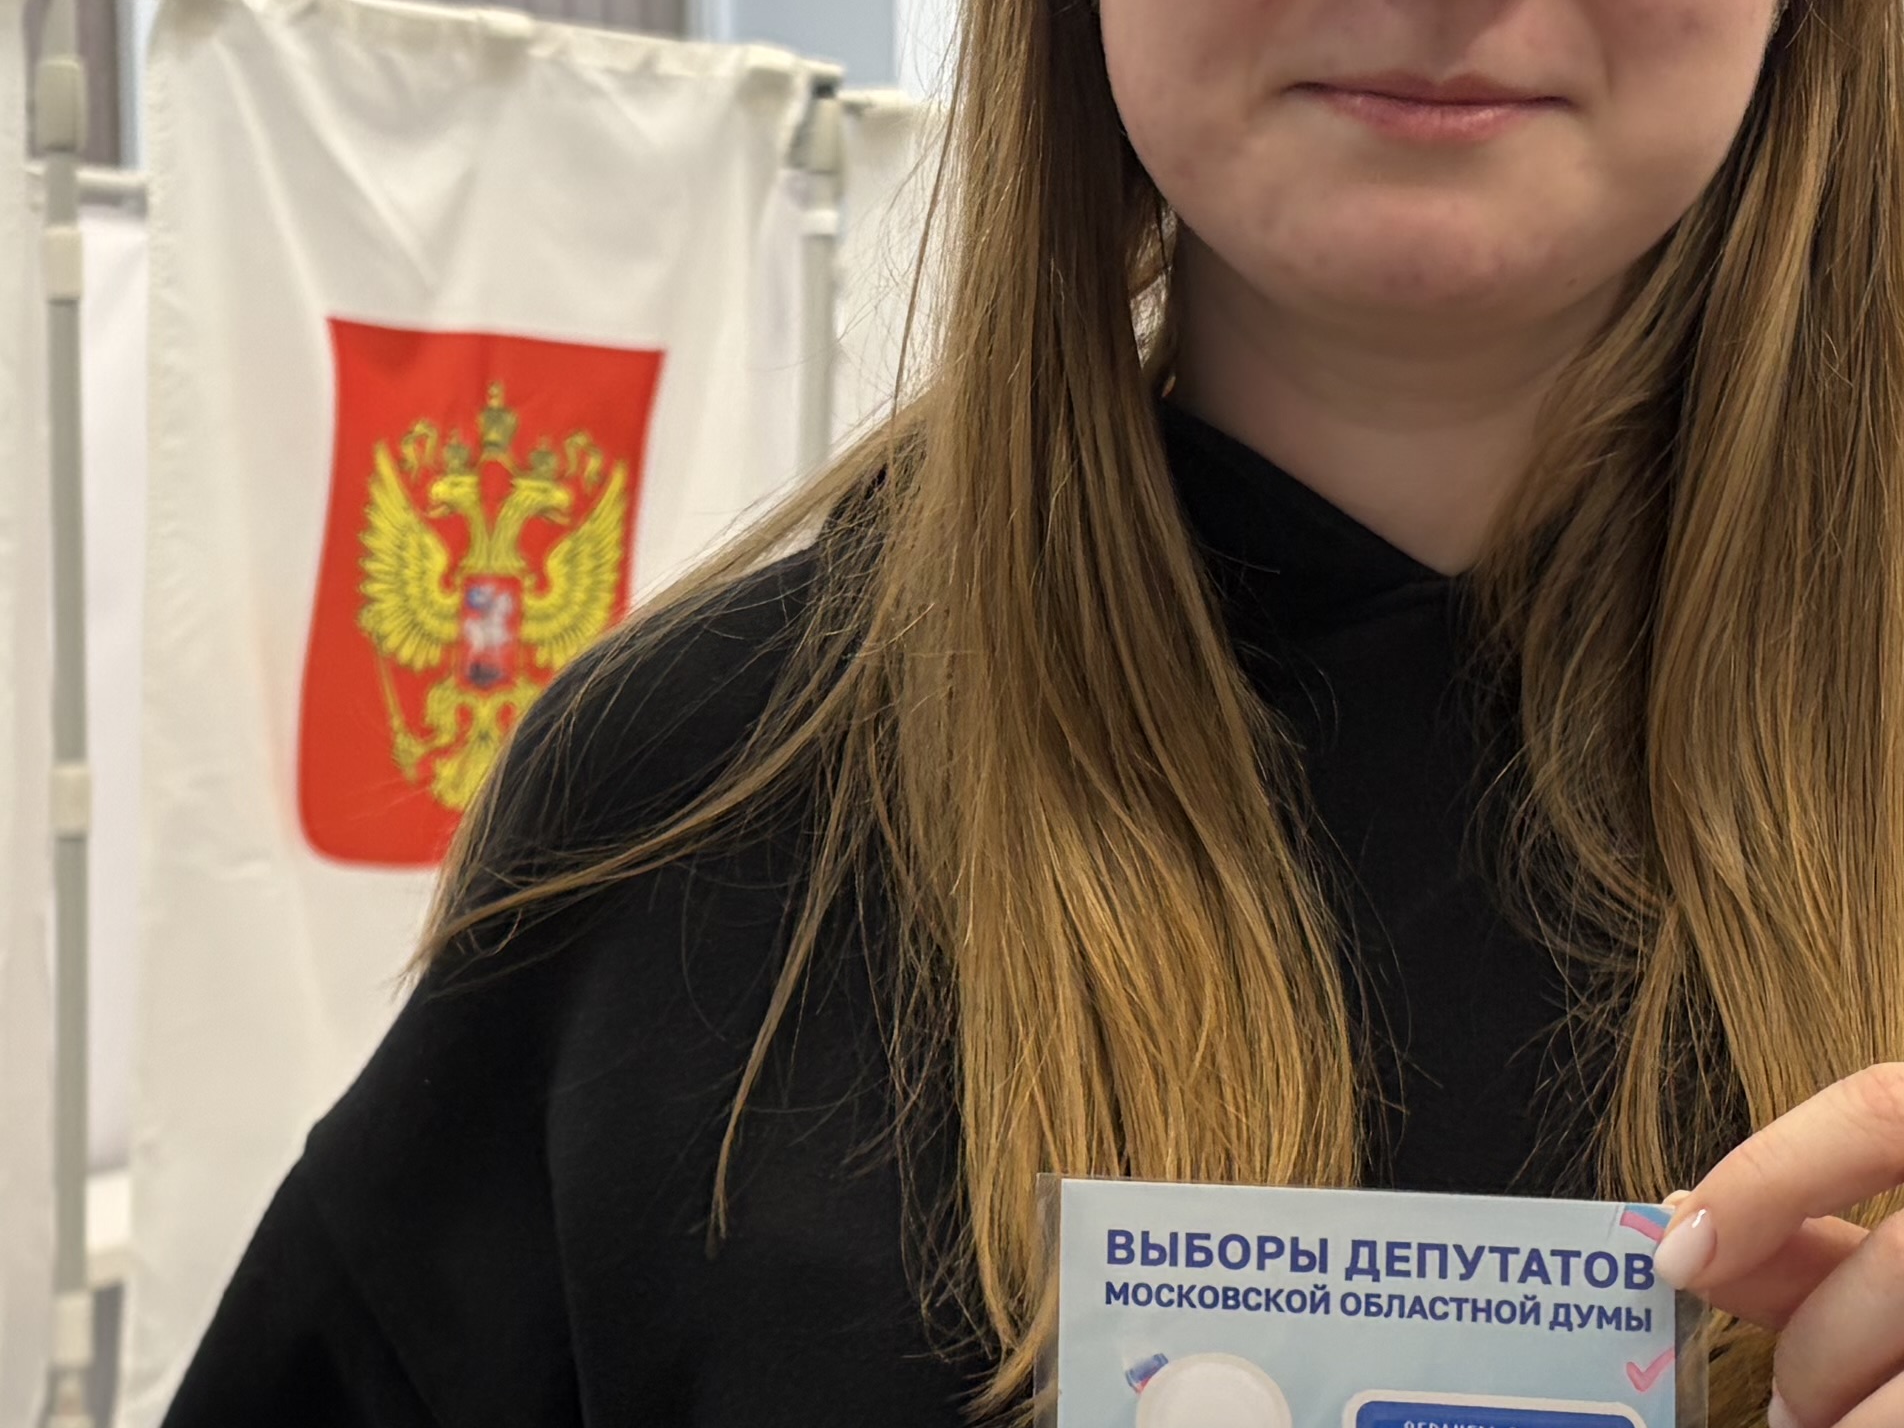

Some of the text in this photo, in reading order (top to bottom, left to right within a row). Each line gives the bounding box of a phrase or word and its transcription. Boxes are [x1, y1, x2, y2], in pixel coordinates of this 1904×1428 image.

[1106, 1229, 1655, 1290] ВЫБОРЫ ДЕПУТАТОВ
[1105, 1281, 1652, 1332] МОСКОВСКОЙ ОБЛАСТНОЙ ДУМЫ
